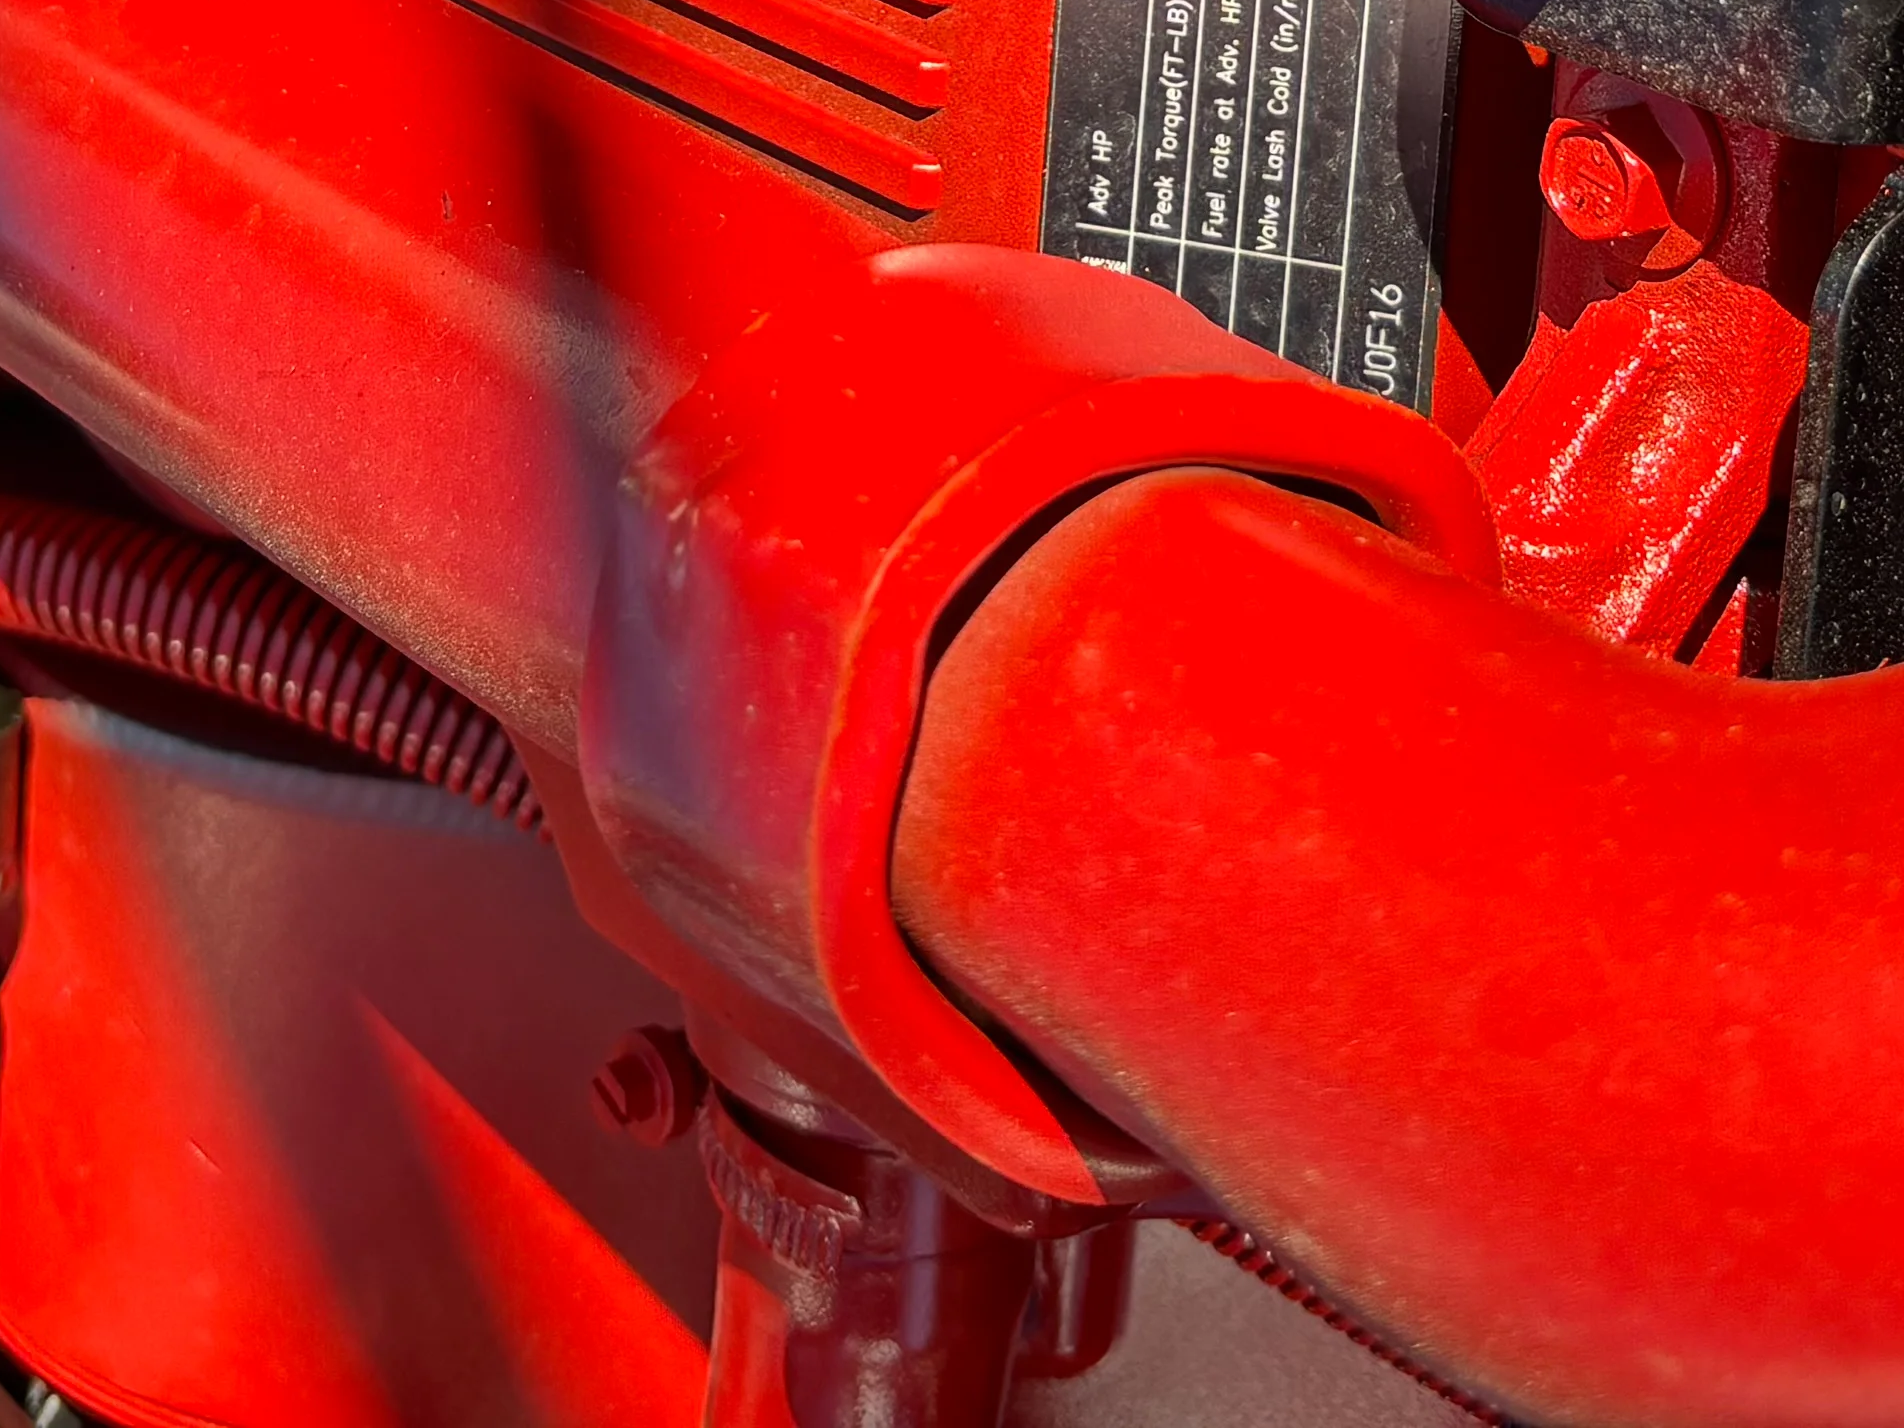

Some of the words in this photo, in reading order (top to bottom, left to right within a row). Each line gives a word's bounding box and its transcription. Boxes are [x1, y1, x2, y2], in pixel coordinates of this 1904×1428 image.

[1214, 38, 1240, 85] Adv.
[1212, 97, 1235, 121] at
[1265, 65, 1292, 115] Cold
[1090, 128, 1113, 162] HP
[1208, 132, 1232, 179] rate
[1261, 128, 1286, 182] Lash
[1086, 173, 1111, 216] Adv
[1148, 174, 1174, 230] Peak
[1200, 190, 1227, 238] Fuel
[1254, 193, 1281, 251] Valve
[1362, 282, 1403, 402] J0F16
